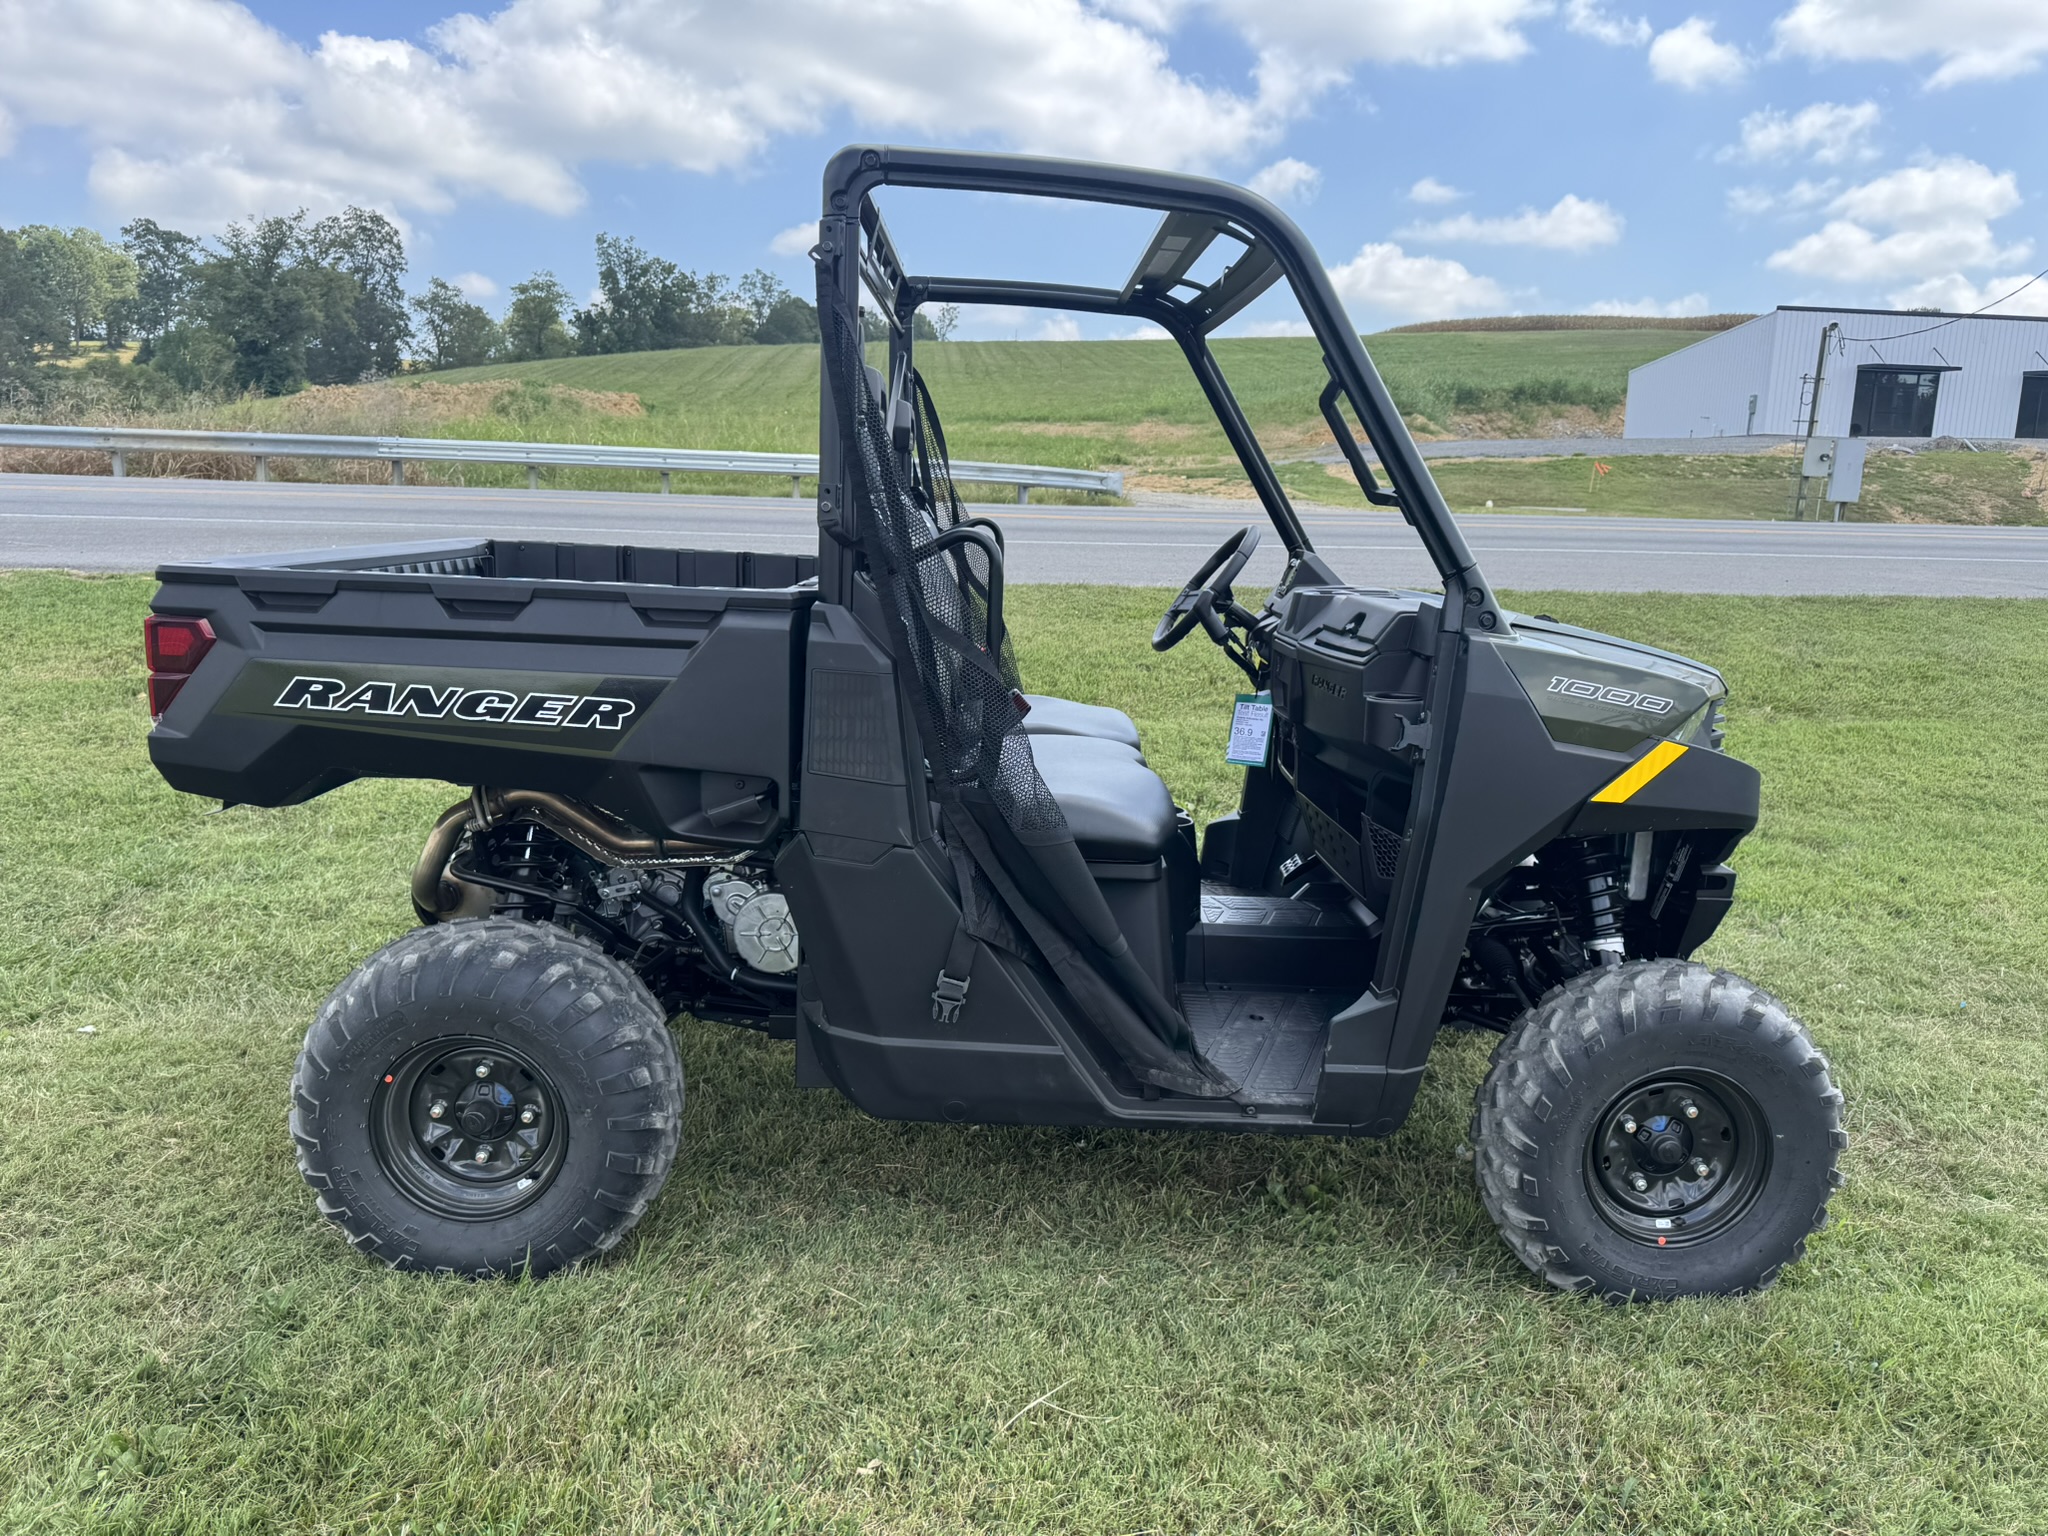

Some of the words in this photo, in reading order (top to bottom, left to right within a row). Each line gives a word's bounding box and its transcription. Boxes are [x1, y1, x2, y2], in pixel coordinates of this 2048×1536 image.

[273, 675, 636, 730] RANGER
[1240, 703, 1250, 711] Tilt
[1251, 704, 1269, 712] Table
[1546, 675, 1674, 713] 1000
[1234, 727, 1253, 737] 36.9
[331, 1164, 422, 1254] CARLSTAR
[1579, 1240, 1680, 1290] CARLSTAR
